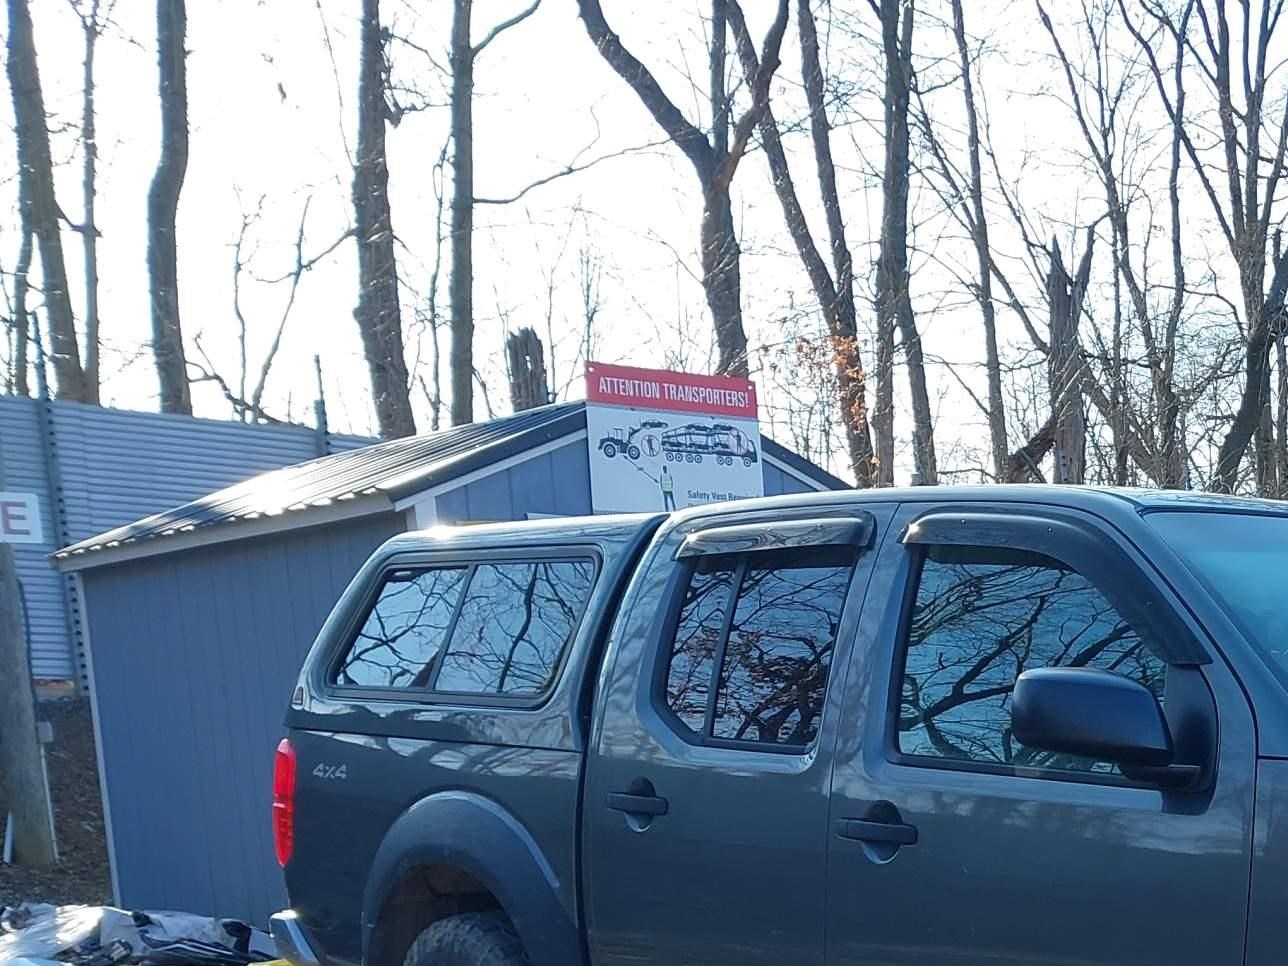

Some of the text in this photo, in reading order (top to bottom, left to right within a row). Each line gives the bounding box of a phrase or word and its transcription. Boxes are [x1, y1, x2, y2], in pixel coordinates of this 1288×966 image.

[598, 376, 749, 408] ATTENTION TRANSPORTERS!
[687, 489, 710, 501] Safety
[711, 491, 727, 500] Vest
